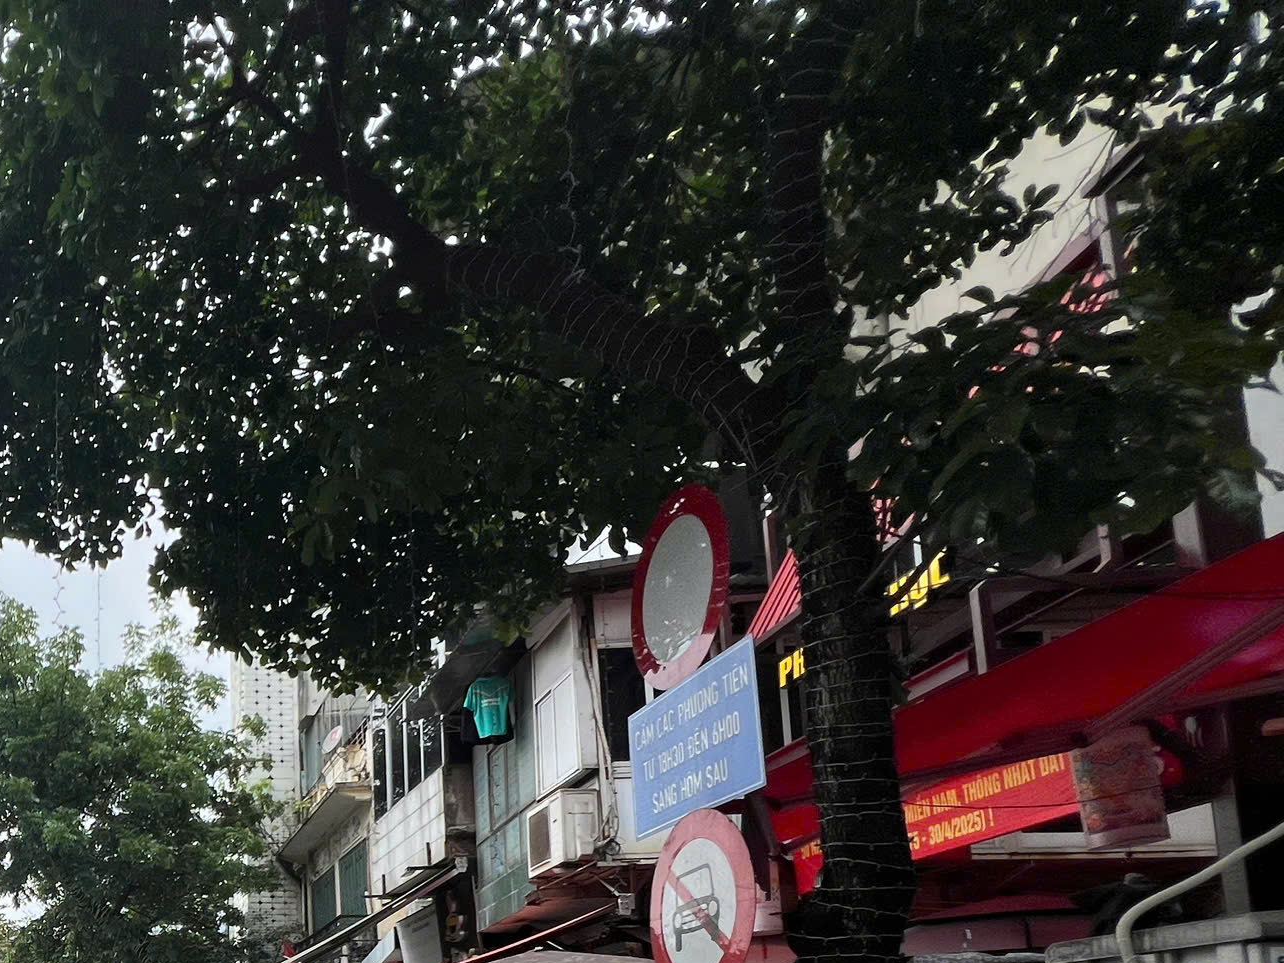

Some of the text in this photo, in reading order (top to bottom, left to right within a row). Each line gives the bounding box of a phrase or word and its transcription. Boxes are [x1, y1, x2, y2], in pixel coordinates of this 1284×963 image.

[712, 711, 741, 746] 6H00
[680, 767, 704, 801] HÔM
[706, 758, 730, 790] SAU
